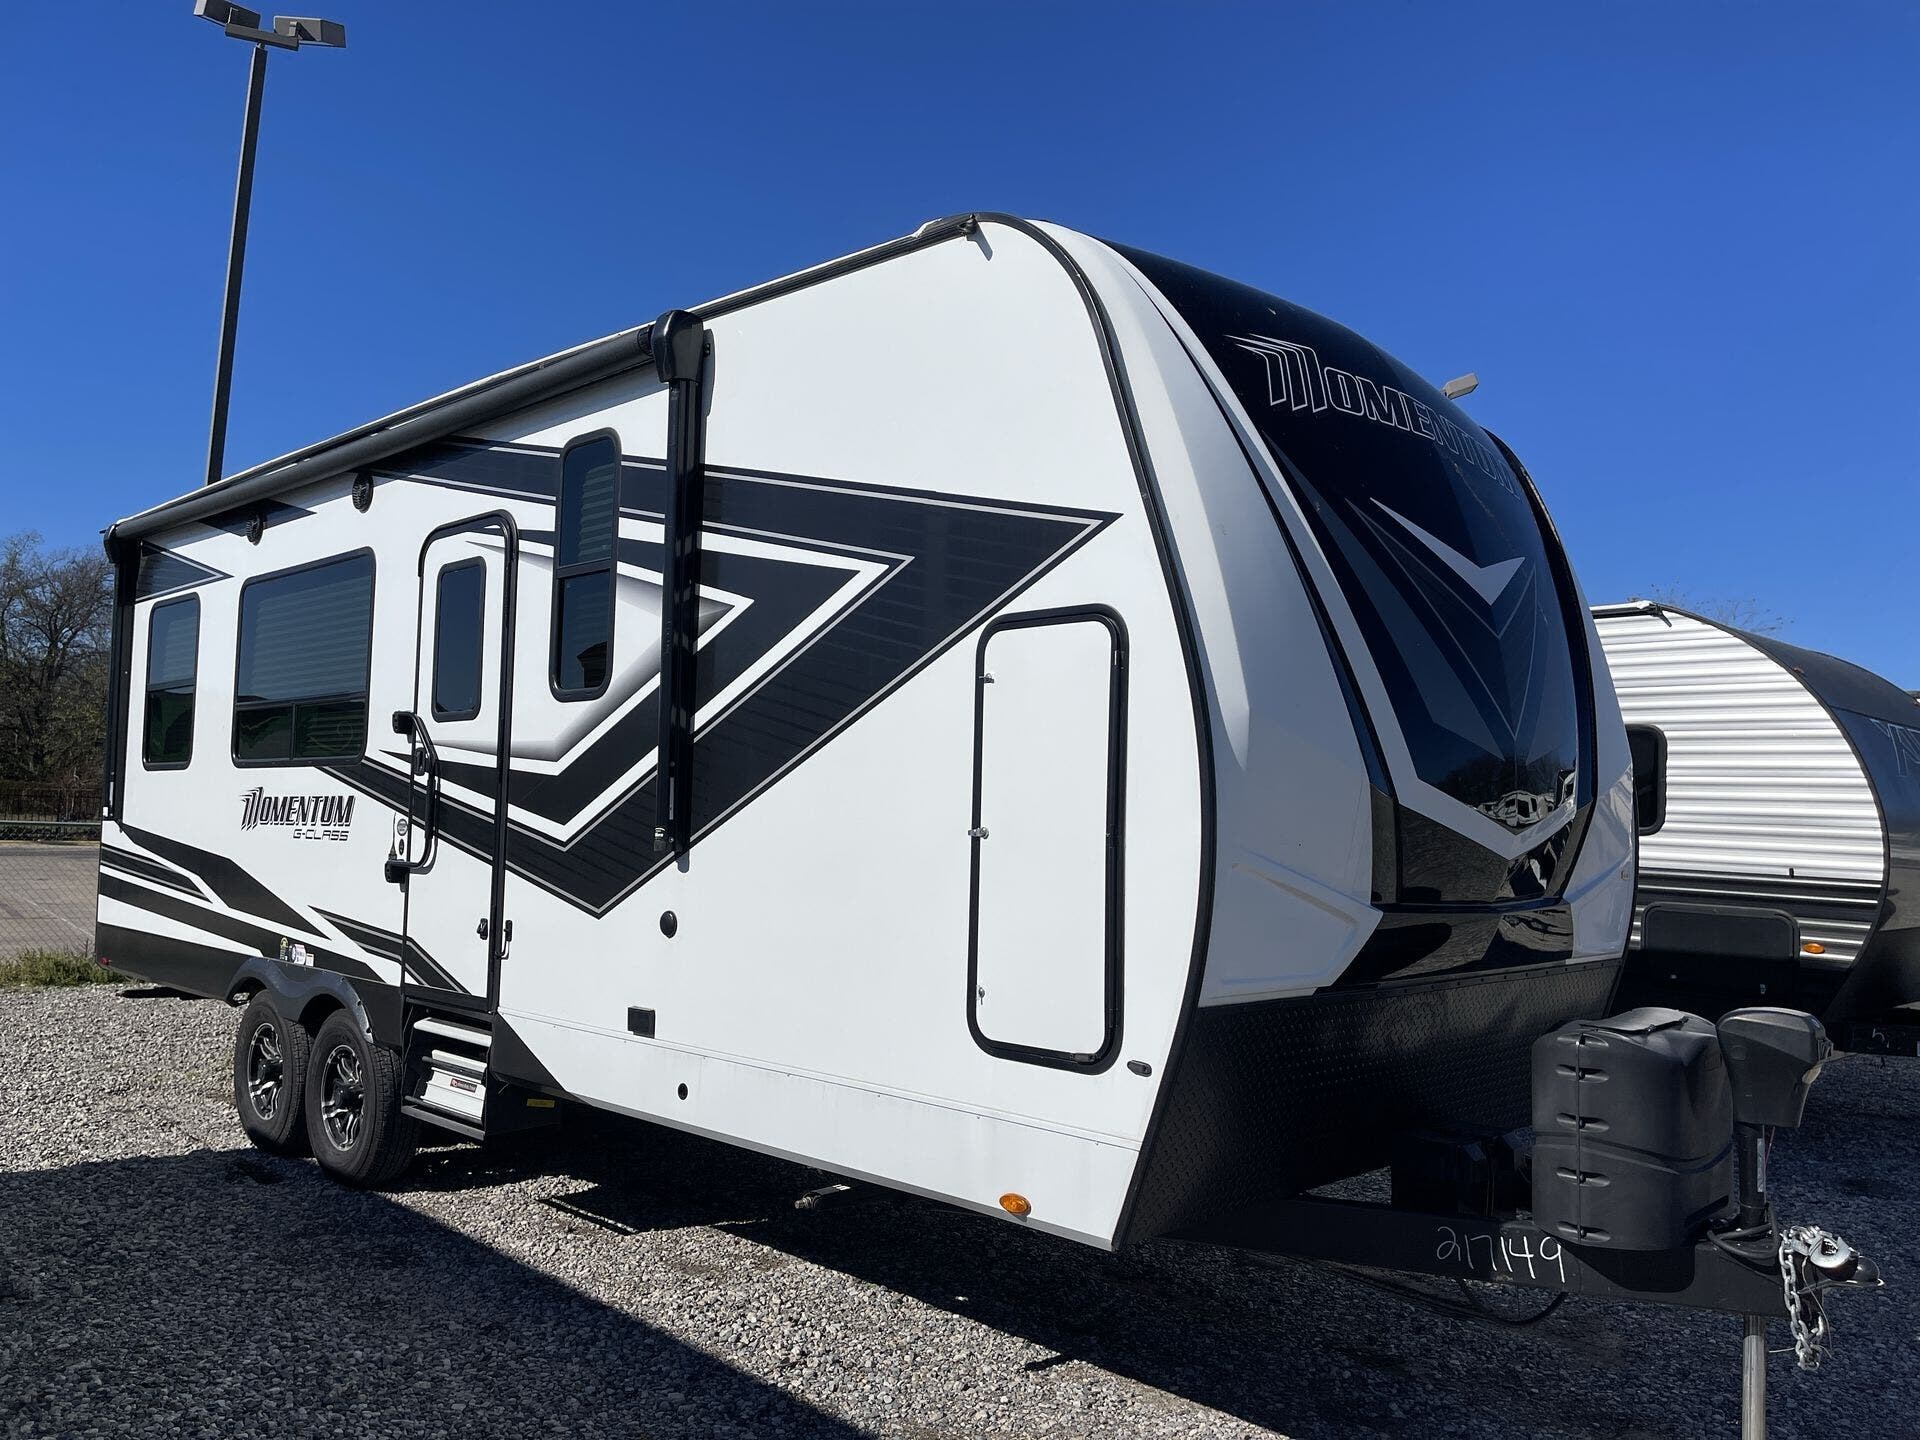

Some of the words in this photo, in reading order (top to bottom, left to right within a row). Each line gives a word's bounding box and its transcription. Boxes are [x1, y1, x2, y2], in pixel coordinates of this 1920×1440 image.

[240, 786, 356, 831] MOMENTUM
[293, 829, 349, 841] G-CLASS
[1437, 1226, 1566, 1283] 217149
